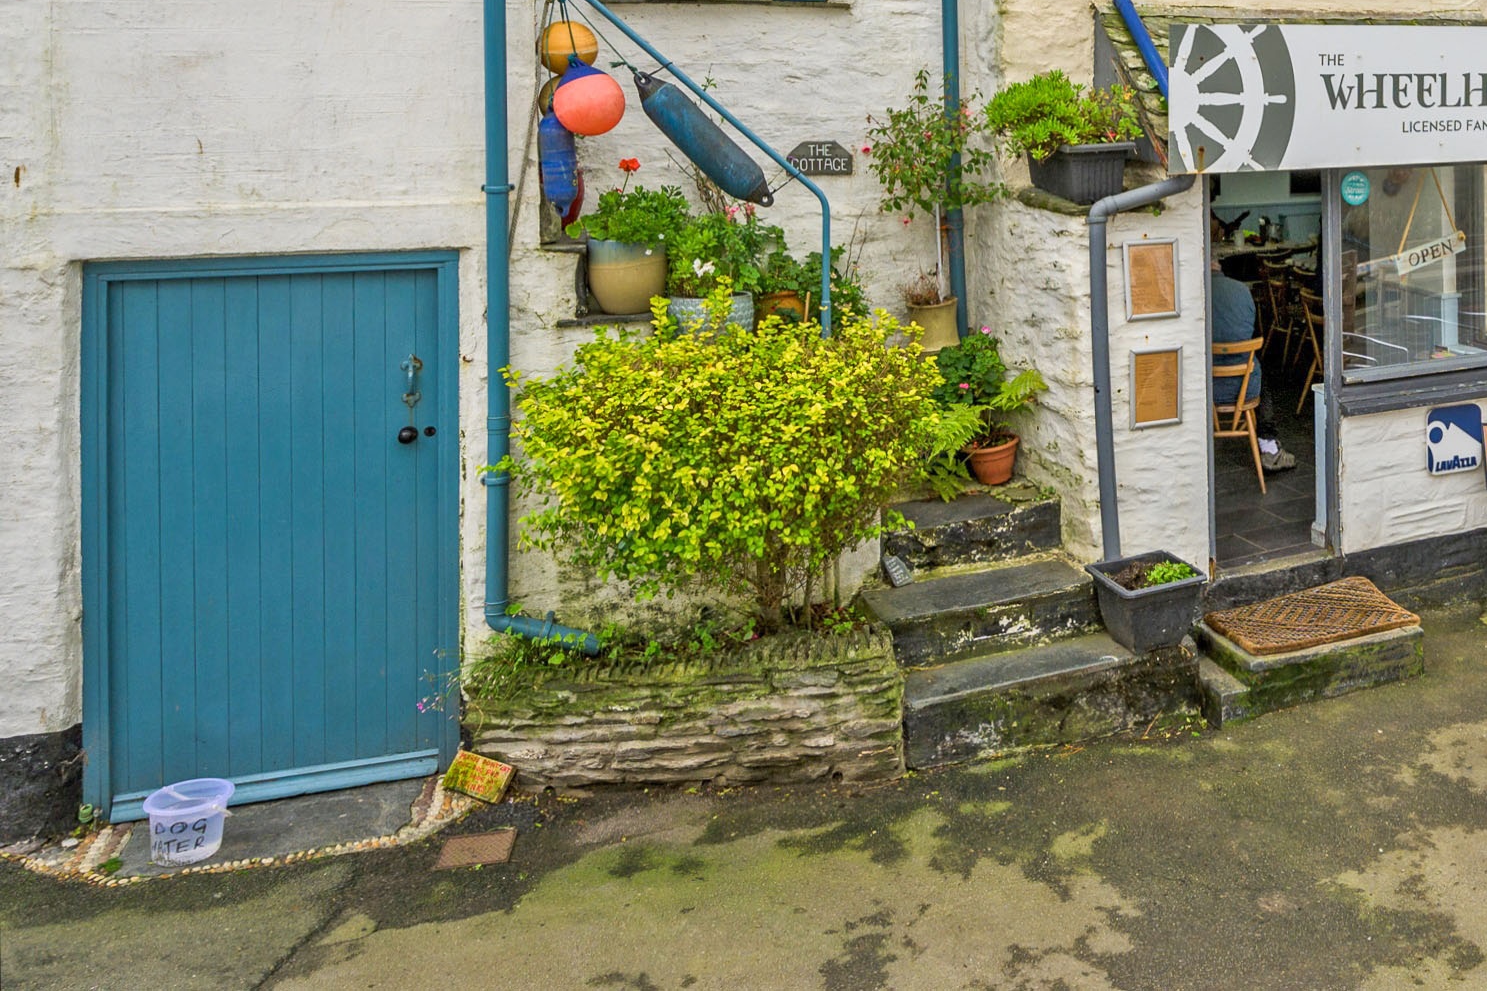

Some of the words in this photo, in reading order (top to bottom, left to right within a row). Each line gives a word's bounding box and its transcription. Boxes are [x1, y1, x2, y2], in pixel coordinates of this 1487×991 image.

[1318, 53, 1345, 67] THE
[1401, 119, 1463, 134] LICENSED
[808, 144, 832, 156] THE
[791, 158, 848, 171] COTTAGE
[1408, 238, 1454, 267] OPEN
[1435, 455, 1477, 472] LAVAZZA
[155, 818, 208, 835] DOG
